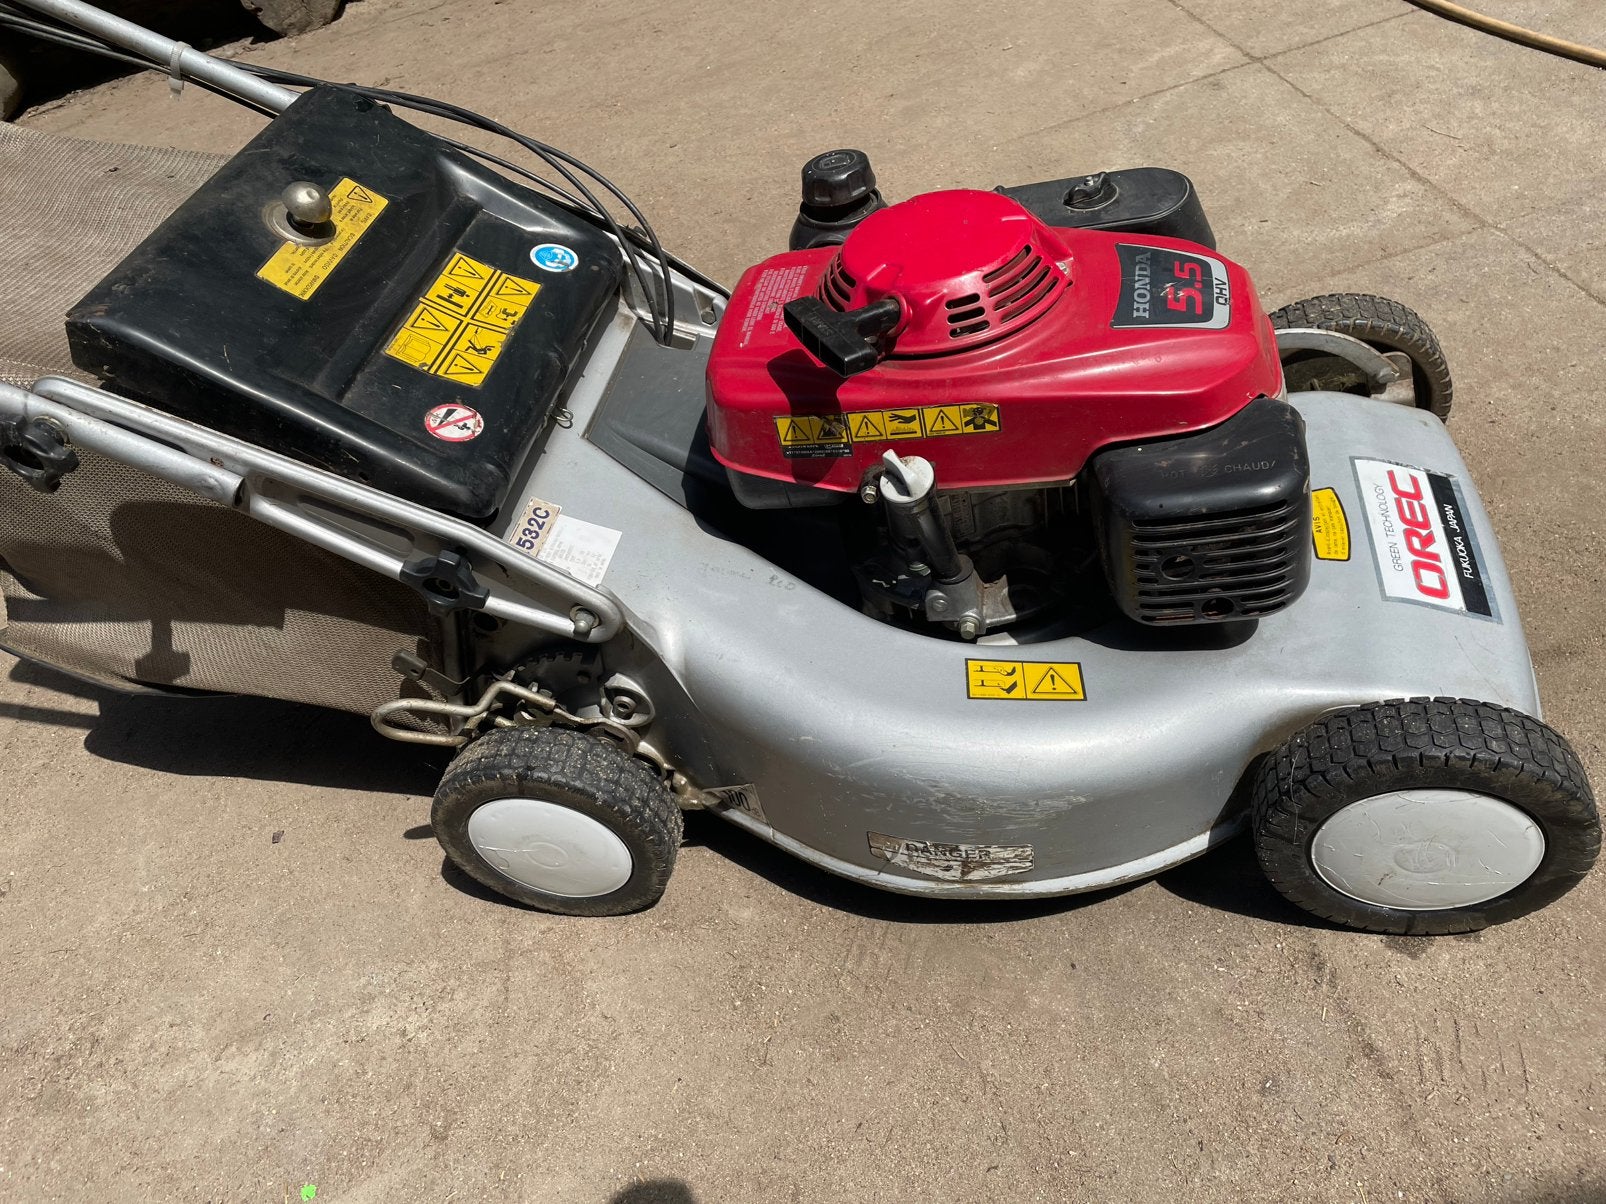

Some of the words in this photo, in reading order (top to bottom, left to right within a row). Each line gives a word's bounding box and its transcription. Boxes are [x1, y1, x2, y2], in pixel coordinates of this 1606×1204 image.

[1133, 252, 1151, 318] HONDA
[1167, 261, 1203, 315] 5.5
[515, 506, 551, 551] 532C
[1312, 517, 1323, 534] AVIS
[1375, 483, 1395, 538] TECHNOLOGY
[1444, 504, 1460, 533] JAPAN
[1387, 469, 1450, 600] OREC
[1389, 542, 1404, 572] GREEN
[1454, 536, 1474, 579] FUKUOKA
